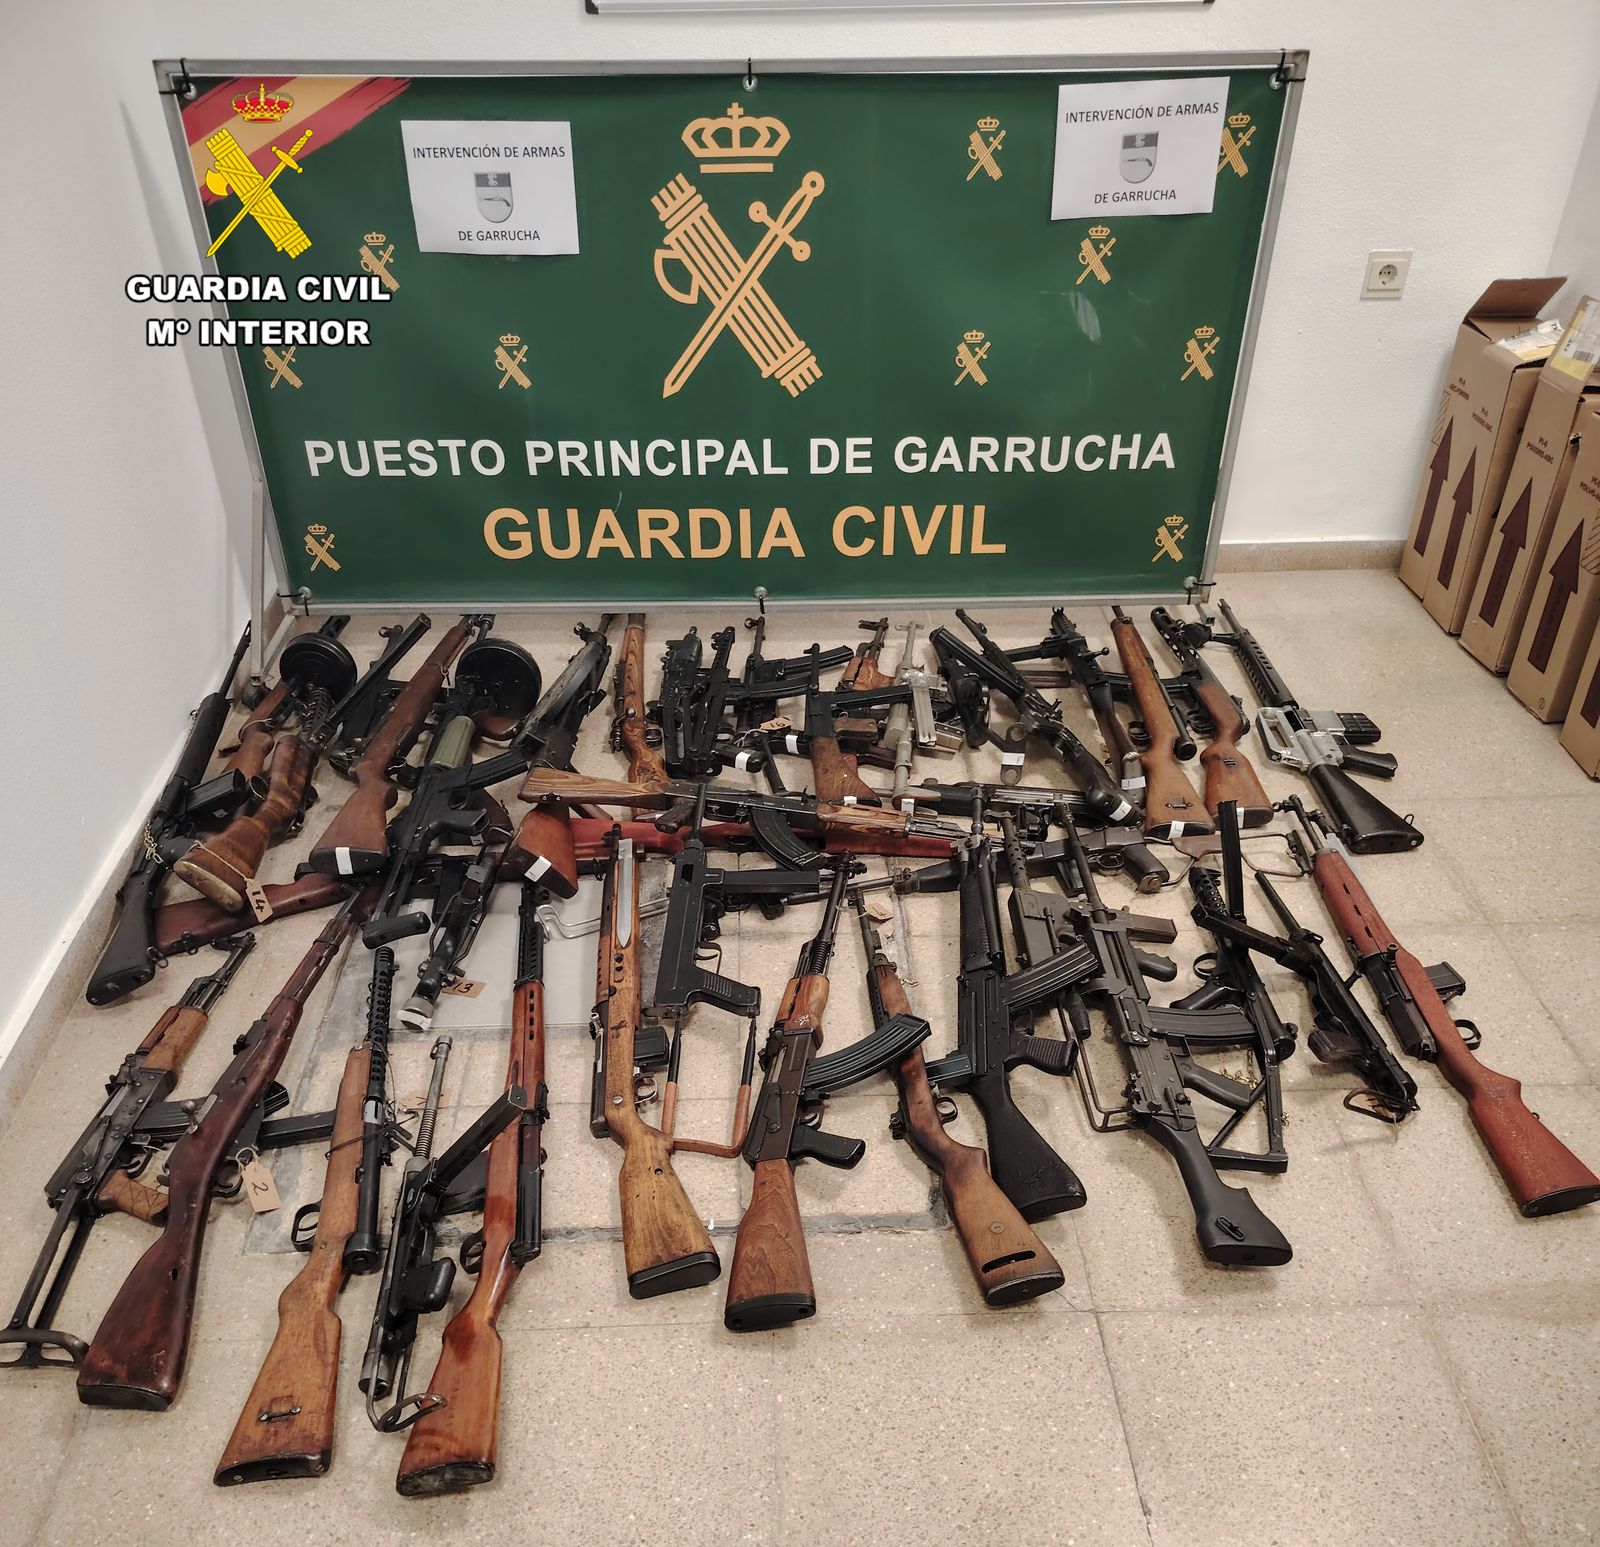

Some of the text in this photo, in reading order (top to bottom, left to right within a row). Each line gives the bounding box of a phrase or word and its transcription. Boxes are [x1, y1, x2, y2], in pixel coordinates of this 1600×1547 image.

[1065, 102, 1219, 124] INTERVENCIÓN DE ARMAS
[412, 143, 566, 159] INTERVENCIÓN DE ARMAS
[1094, 189, 1177, 204] DE GARRUCHA
[458, 230, 541, 242] DE GARRUCHA
[304, 432, 1176, 477] PUESTO PRINCIPAL DE GARRUCHA
[483, 504, 1007, 560] GUARDIA CIVIL
[252, 891, 265, 912] 14
[453, 981, 473, 993] 13
[252, 1182, 269, 1196] 2
